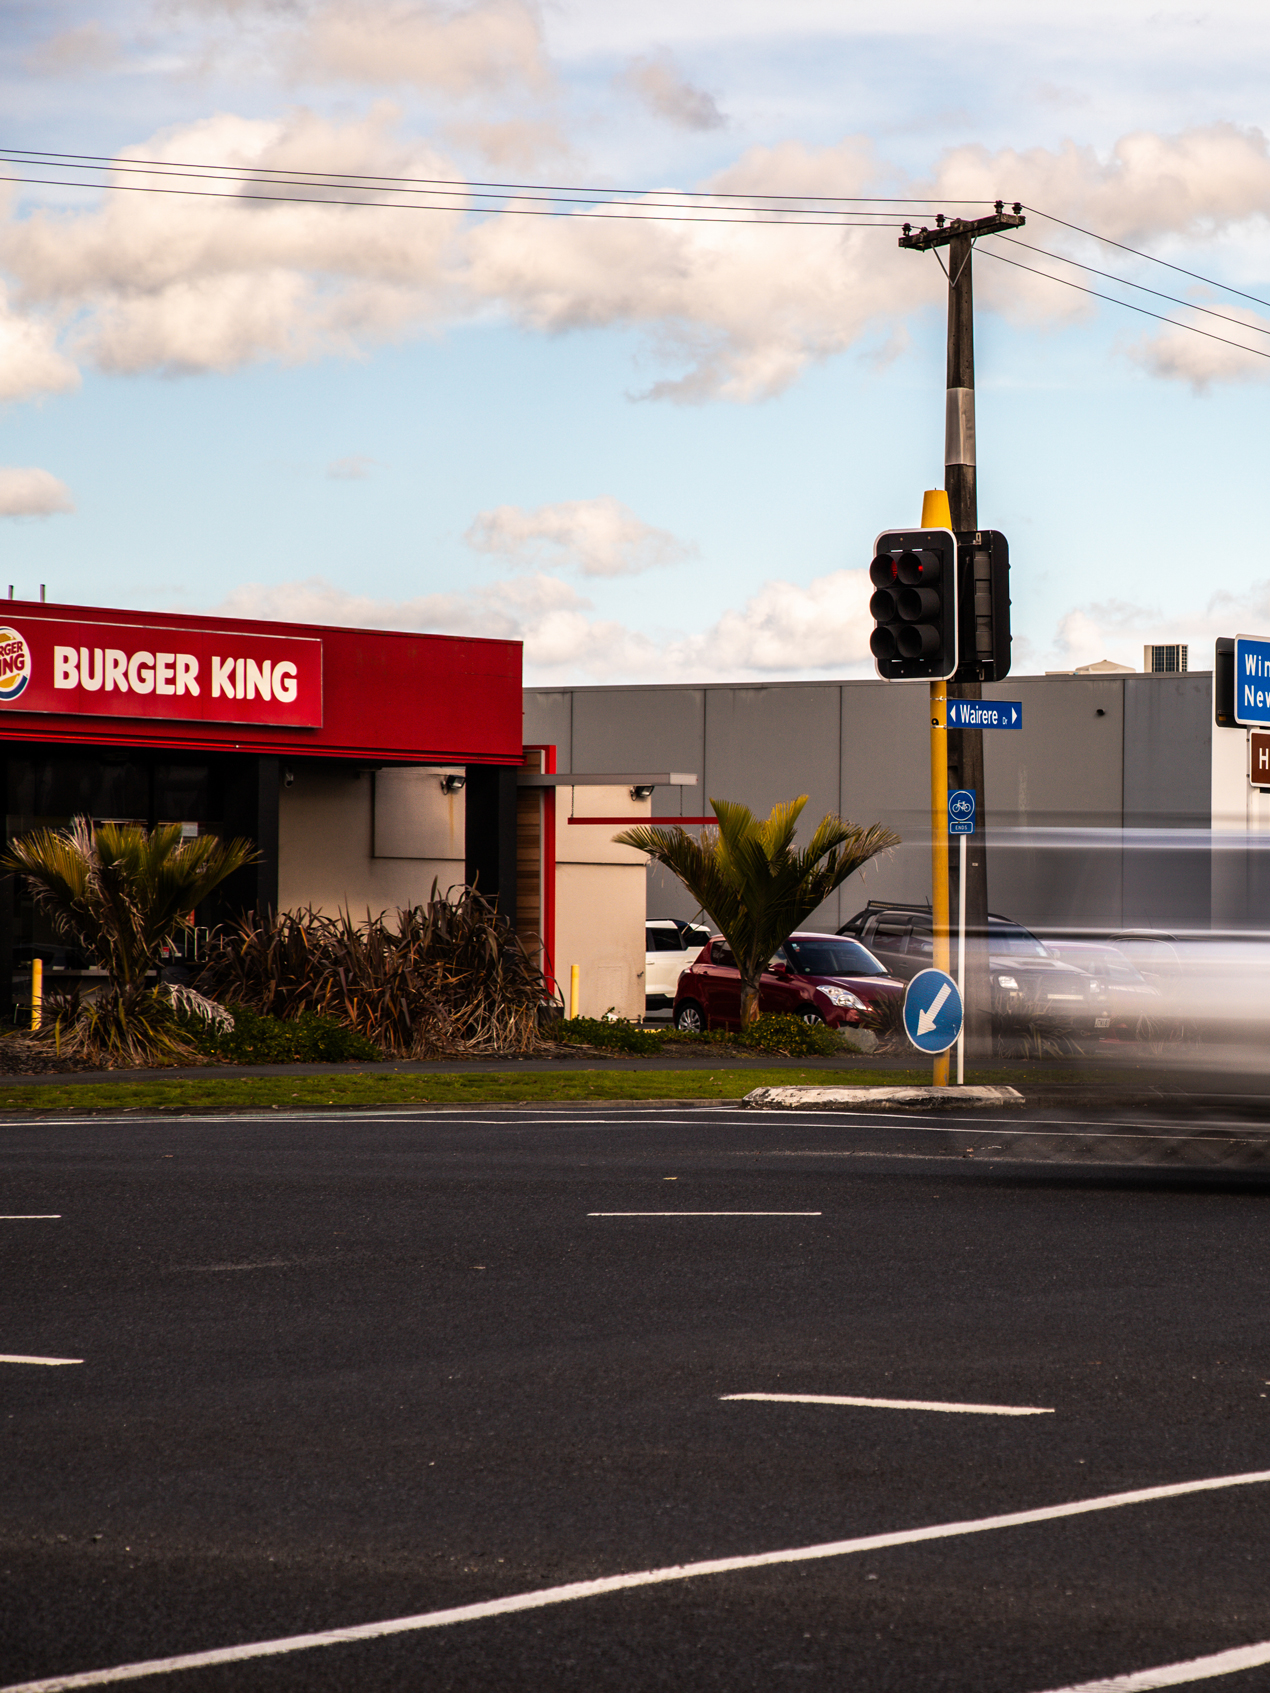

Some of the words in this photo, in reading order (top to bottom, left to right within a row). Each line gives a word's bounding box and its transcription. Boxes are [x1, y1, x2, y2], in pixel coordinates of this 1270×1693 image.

[0, 641, 23, 657] RGER
[0, 653, 25, 677] NG
[53, 645, 200, 697] BURGER
[212, 656, 298, 703] KING
[960, 704, 998, 725] Wairere
[1002, 716, 1008, 725] Dr
